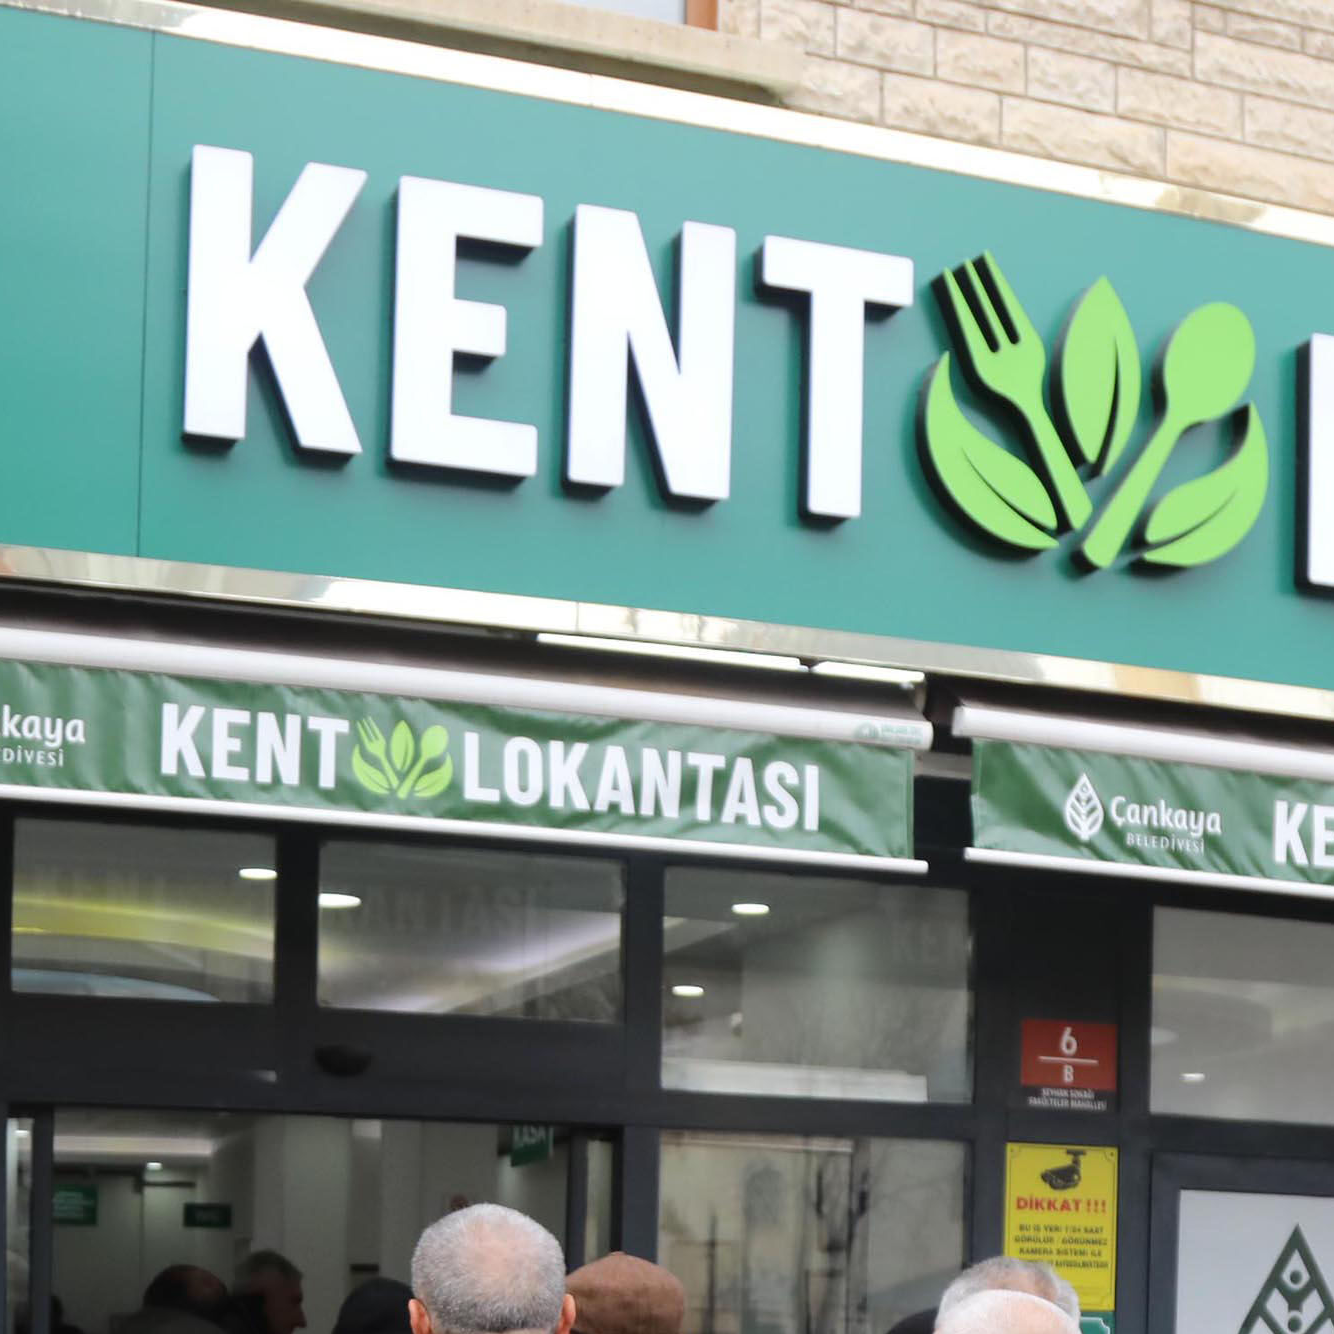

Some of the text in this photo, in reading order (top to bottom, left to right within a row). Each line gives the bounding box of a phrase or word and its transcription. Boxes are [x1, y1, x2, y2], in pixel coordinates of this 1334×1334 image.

[183, 144, 915, 520] KENT
[159, 703, 820, 834] KENT LOKANTASI
[1110, 796, 1223, 838] Çankaya
[1061, 1026, 1078, 1056] 6
[1015, 1193, 1082, 1213] DİKKAT
